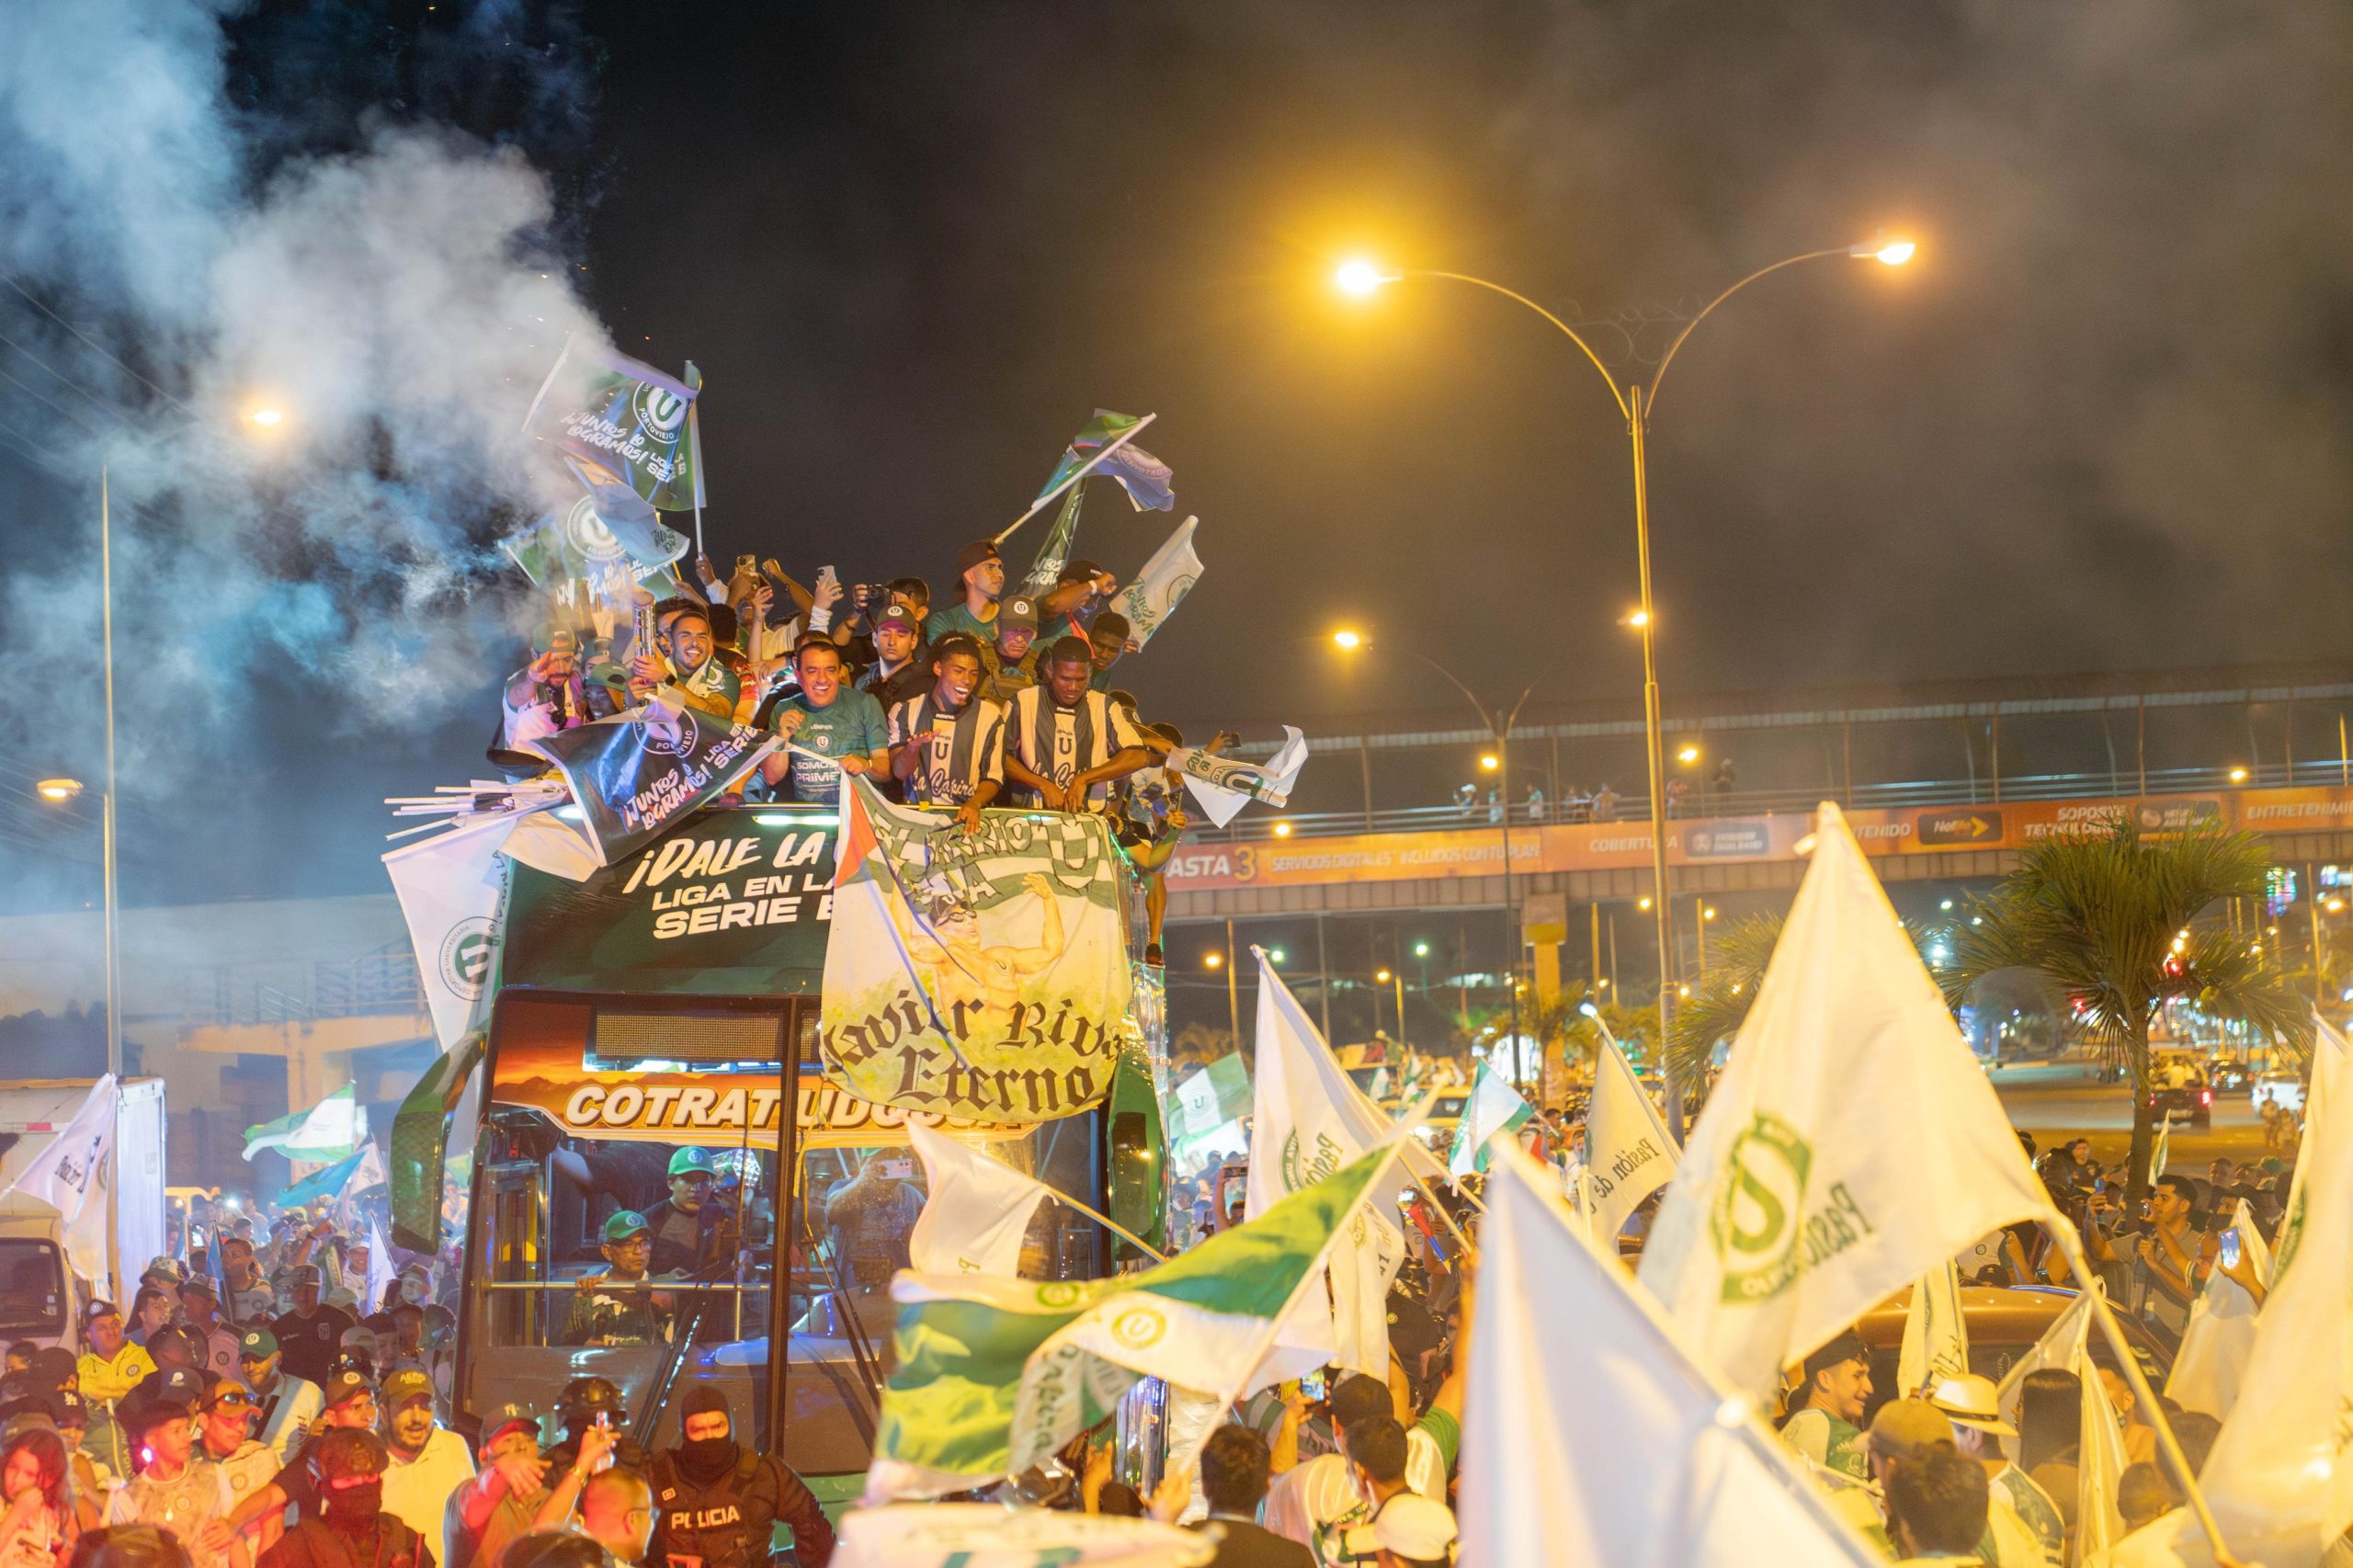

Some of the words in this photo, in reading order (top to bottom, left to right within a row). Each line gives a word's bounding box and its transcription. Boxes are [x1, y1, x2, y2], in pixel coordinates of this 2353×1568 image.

[638, 407, 675, 440] PORTOVIEJO
[655, 390, 682, 423] U
[566, 425, 649, 465] LOGRAMOS!
[713, 724, 759, 769] SERIE
[935, 741, 949, 760] U
[1059, 737, 1073, 756] U
[641, 763, 713, 831] LOGRAMOS!
[703, 739, 731, 763] LIGA
[796, 771, 841, 782] PRIME
[623, 767, 679, 827] ¡JUNTOS
[622, 837, 763, 894] ¡DALE
[772, 831, 827, 869] LA
[1589, 835, 1678, 853] COBERTUA
[1166, 855, 1231, 879] ASTA
[1233, 846, 1256, 882] 3
[652, 882, 732, 911] LIGA
[743, 874, 793, 898] EN
[653, 896, 802, 939] SERIE
[887, 1044, 1101, 1115] Eterno
